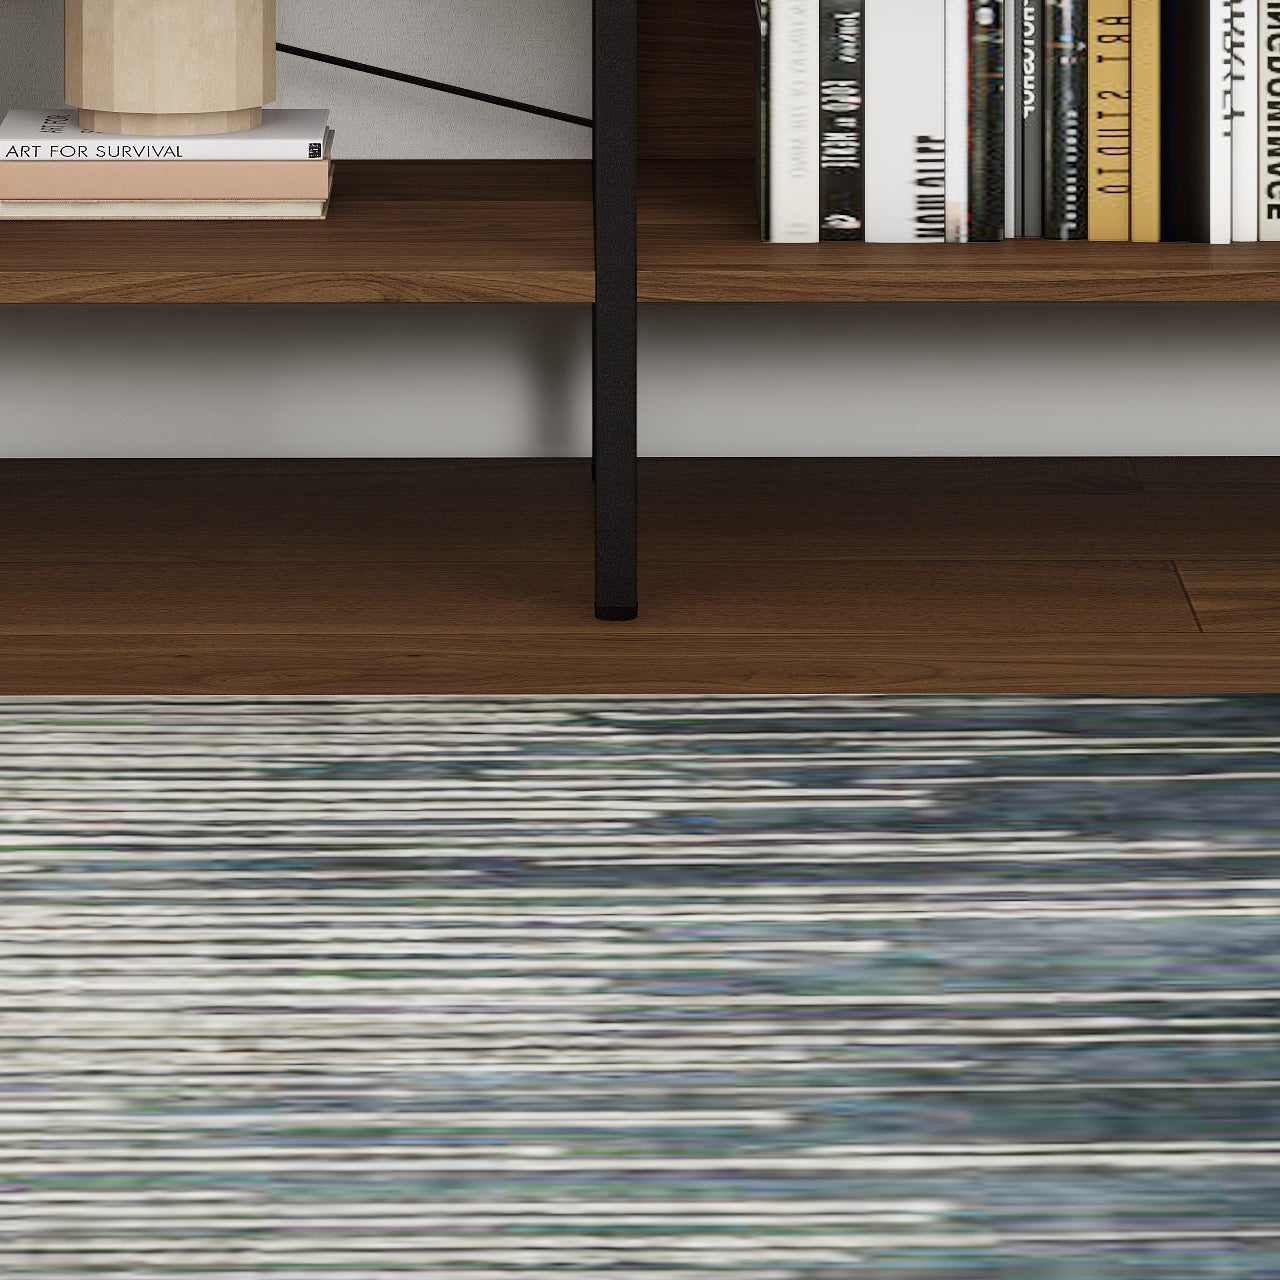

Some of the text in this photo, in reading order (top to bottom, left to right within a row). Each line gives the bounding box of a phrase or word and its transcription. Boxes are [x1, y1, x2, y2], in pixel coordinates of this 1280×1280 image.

[5, 145, 183, 158] ART FOR SURVIVAL
